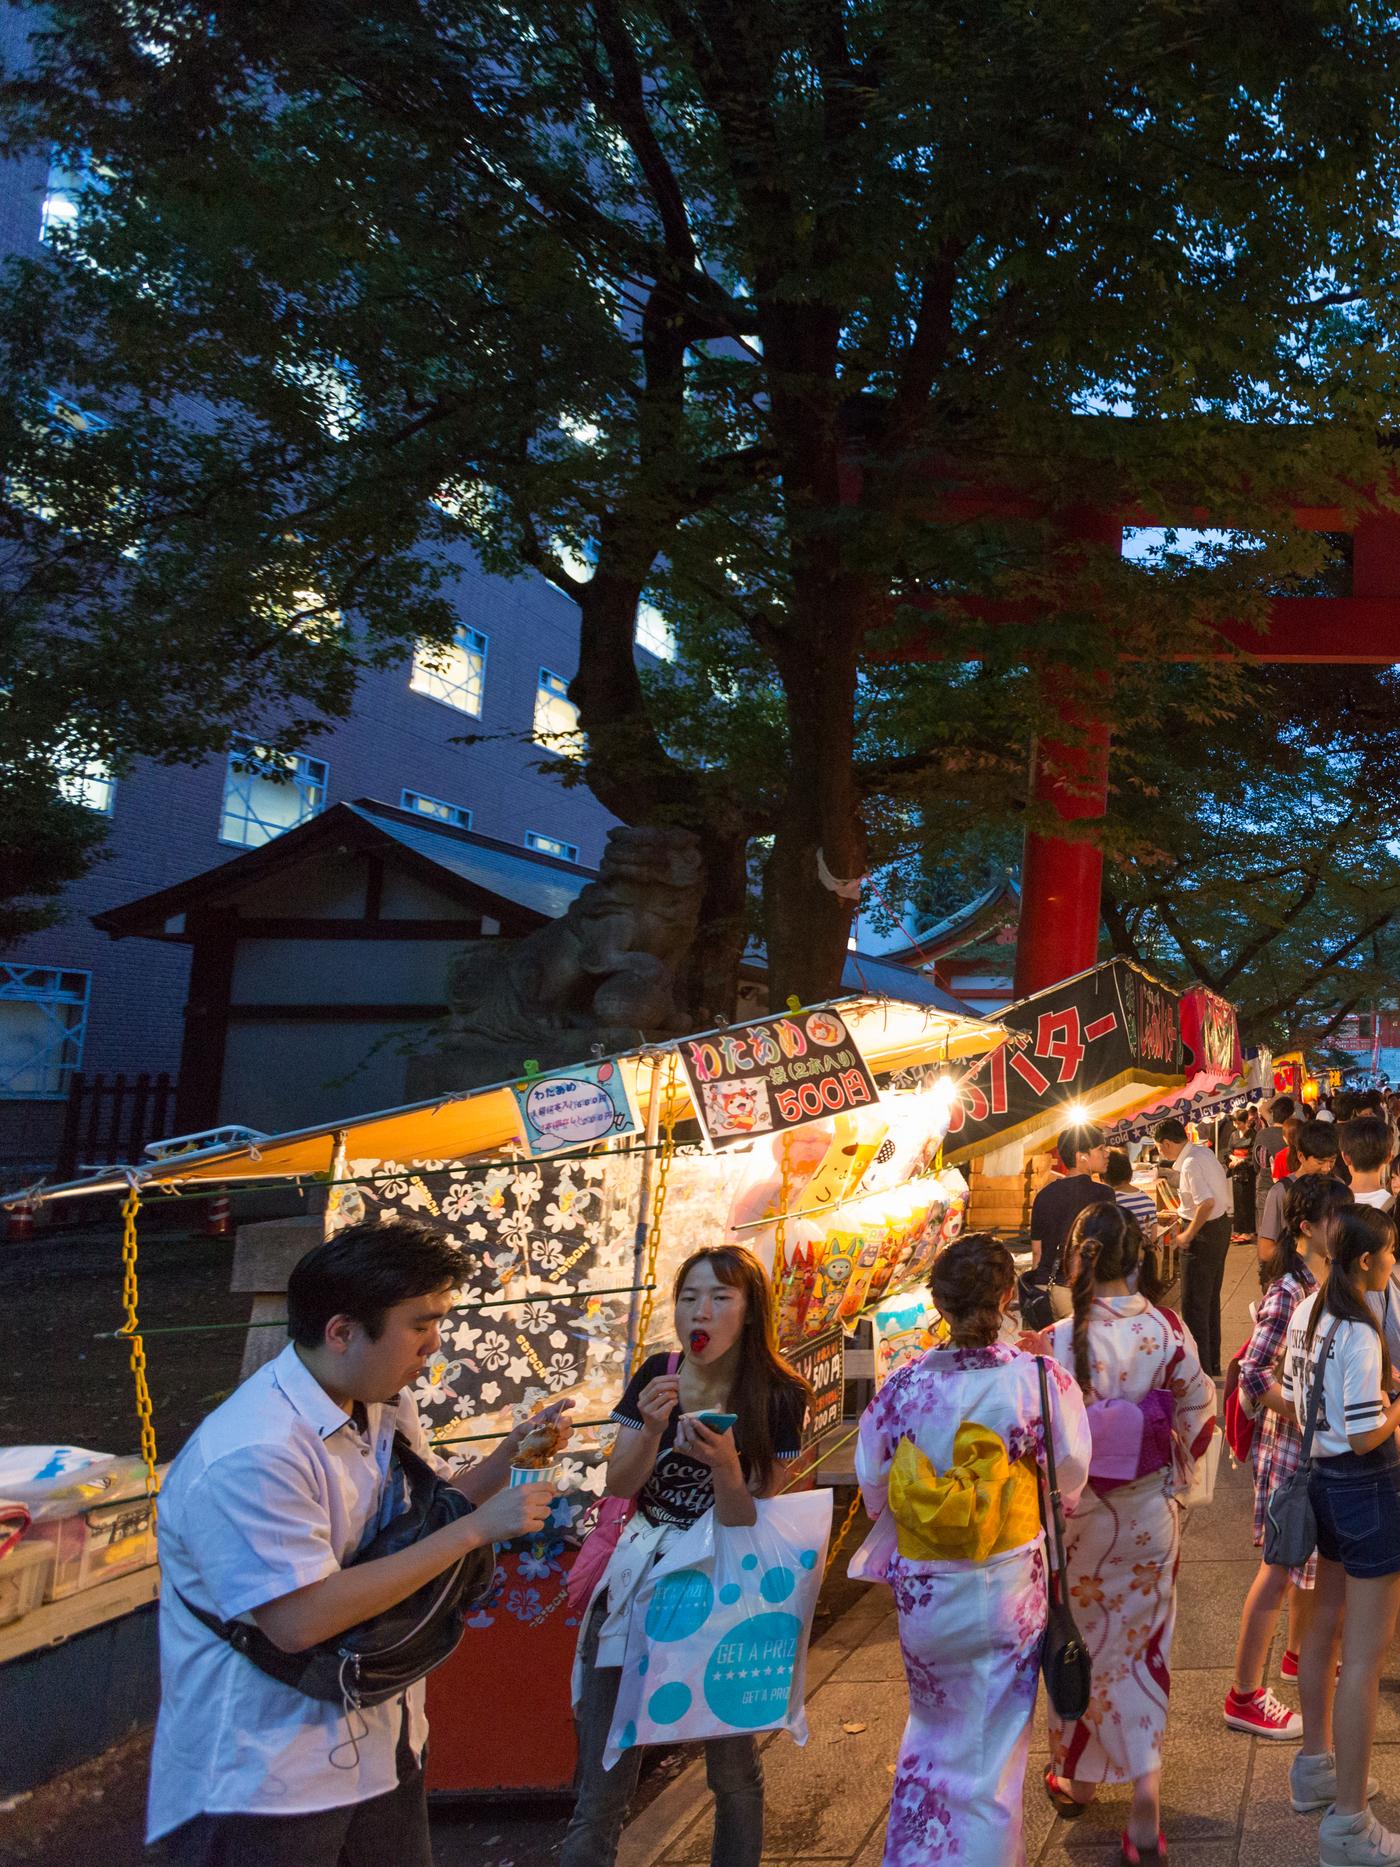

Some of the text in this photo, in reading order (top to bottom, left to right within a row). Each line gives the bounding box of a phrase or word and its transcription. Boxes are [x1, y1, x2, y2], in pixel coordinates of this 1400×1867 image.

[688, 1019, 808, 1082] わたあめ
[534, 1082, 577, 1101] わたあめ
[774, 1069, 871, 1122] 500円
[1109, 1131, 1129, 1145] cold
[813, 1353, 840, 1393] 500円
[716, 1642, 745, 1665] GET
[749, 1642, 758, 1661] A
[742, 1689, 760, 1705] GET
[761, 1688, 768, 1702] A
